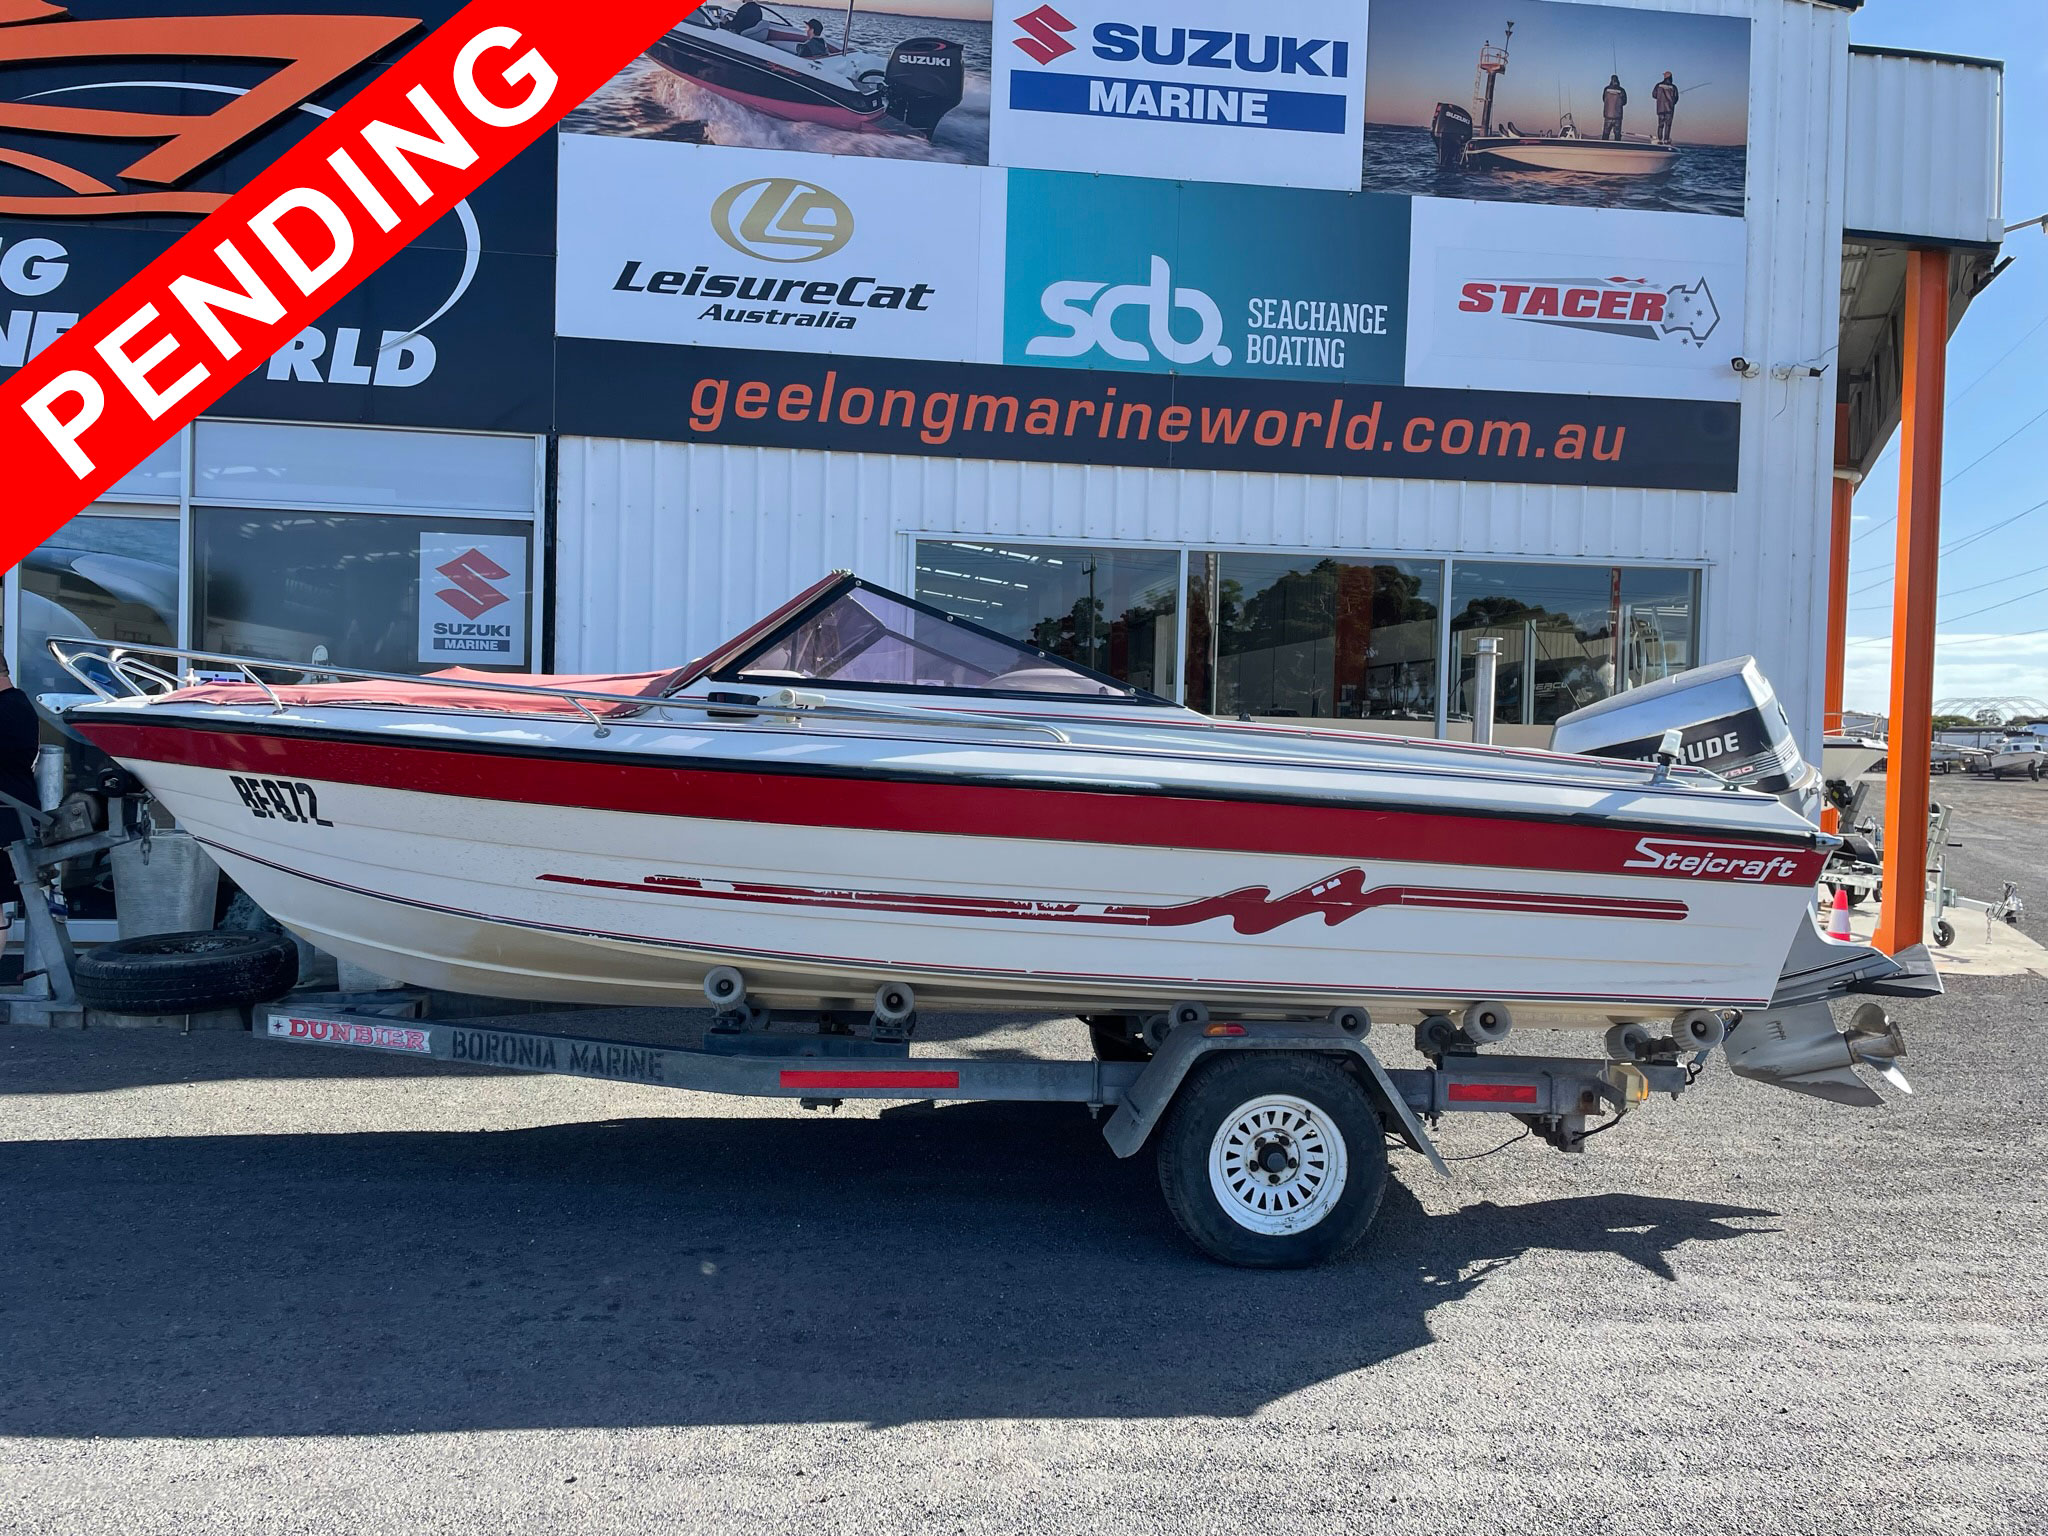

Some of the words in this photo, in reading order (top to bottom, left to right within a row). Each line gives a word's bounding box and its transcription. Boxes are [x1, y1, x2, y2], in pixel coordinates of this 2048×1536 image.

[898, 54, 951, 67] SUZUKI
[1092, 22, 1349, 79] SUZUKI
[1088, 79, 1269, 125] MARINE
[1445, 111, 1471, 126] SUZUKI
[0, 236, 70, 297] G
[612, 260, 936, 311] LeisureCat
[697, 303, 857, 330] Australia
[1247, 297, 1388, 335] SEACHANGE
[1458, 282, 1668, 322] STACER
[250, 325, 437, 388] RLD
[1246, 334, 1346, 369] BOATING
[689, 371, 1626, 463] geelongmarineworld.com.au
[433, 622, 511, 637] SUZUKI
[444, 639, 499, 651] MARINE
[1623, 837, 1807, 882] Stejcraft
[288, 1018, 425, 1052] DUNBIER
[451, 1030, 557, 1070] BORONIA
[568, 1043, 665, 1082] MARINE
